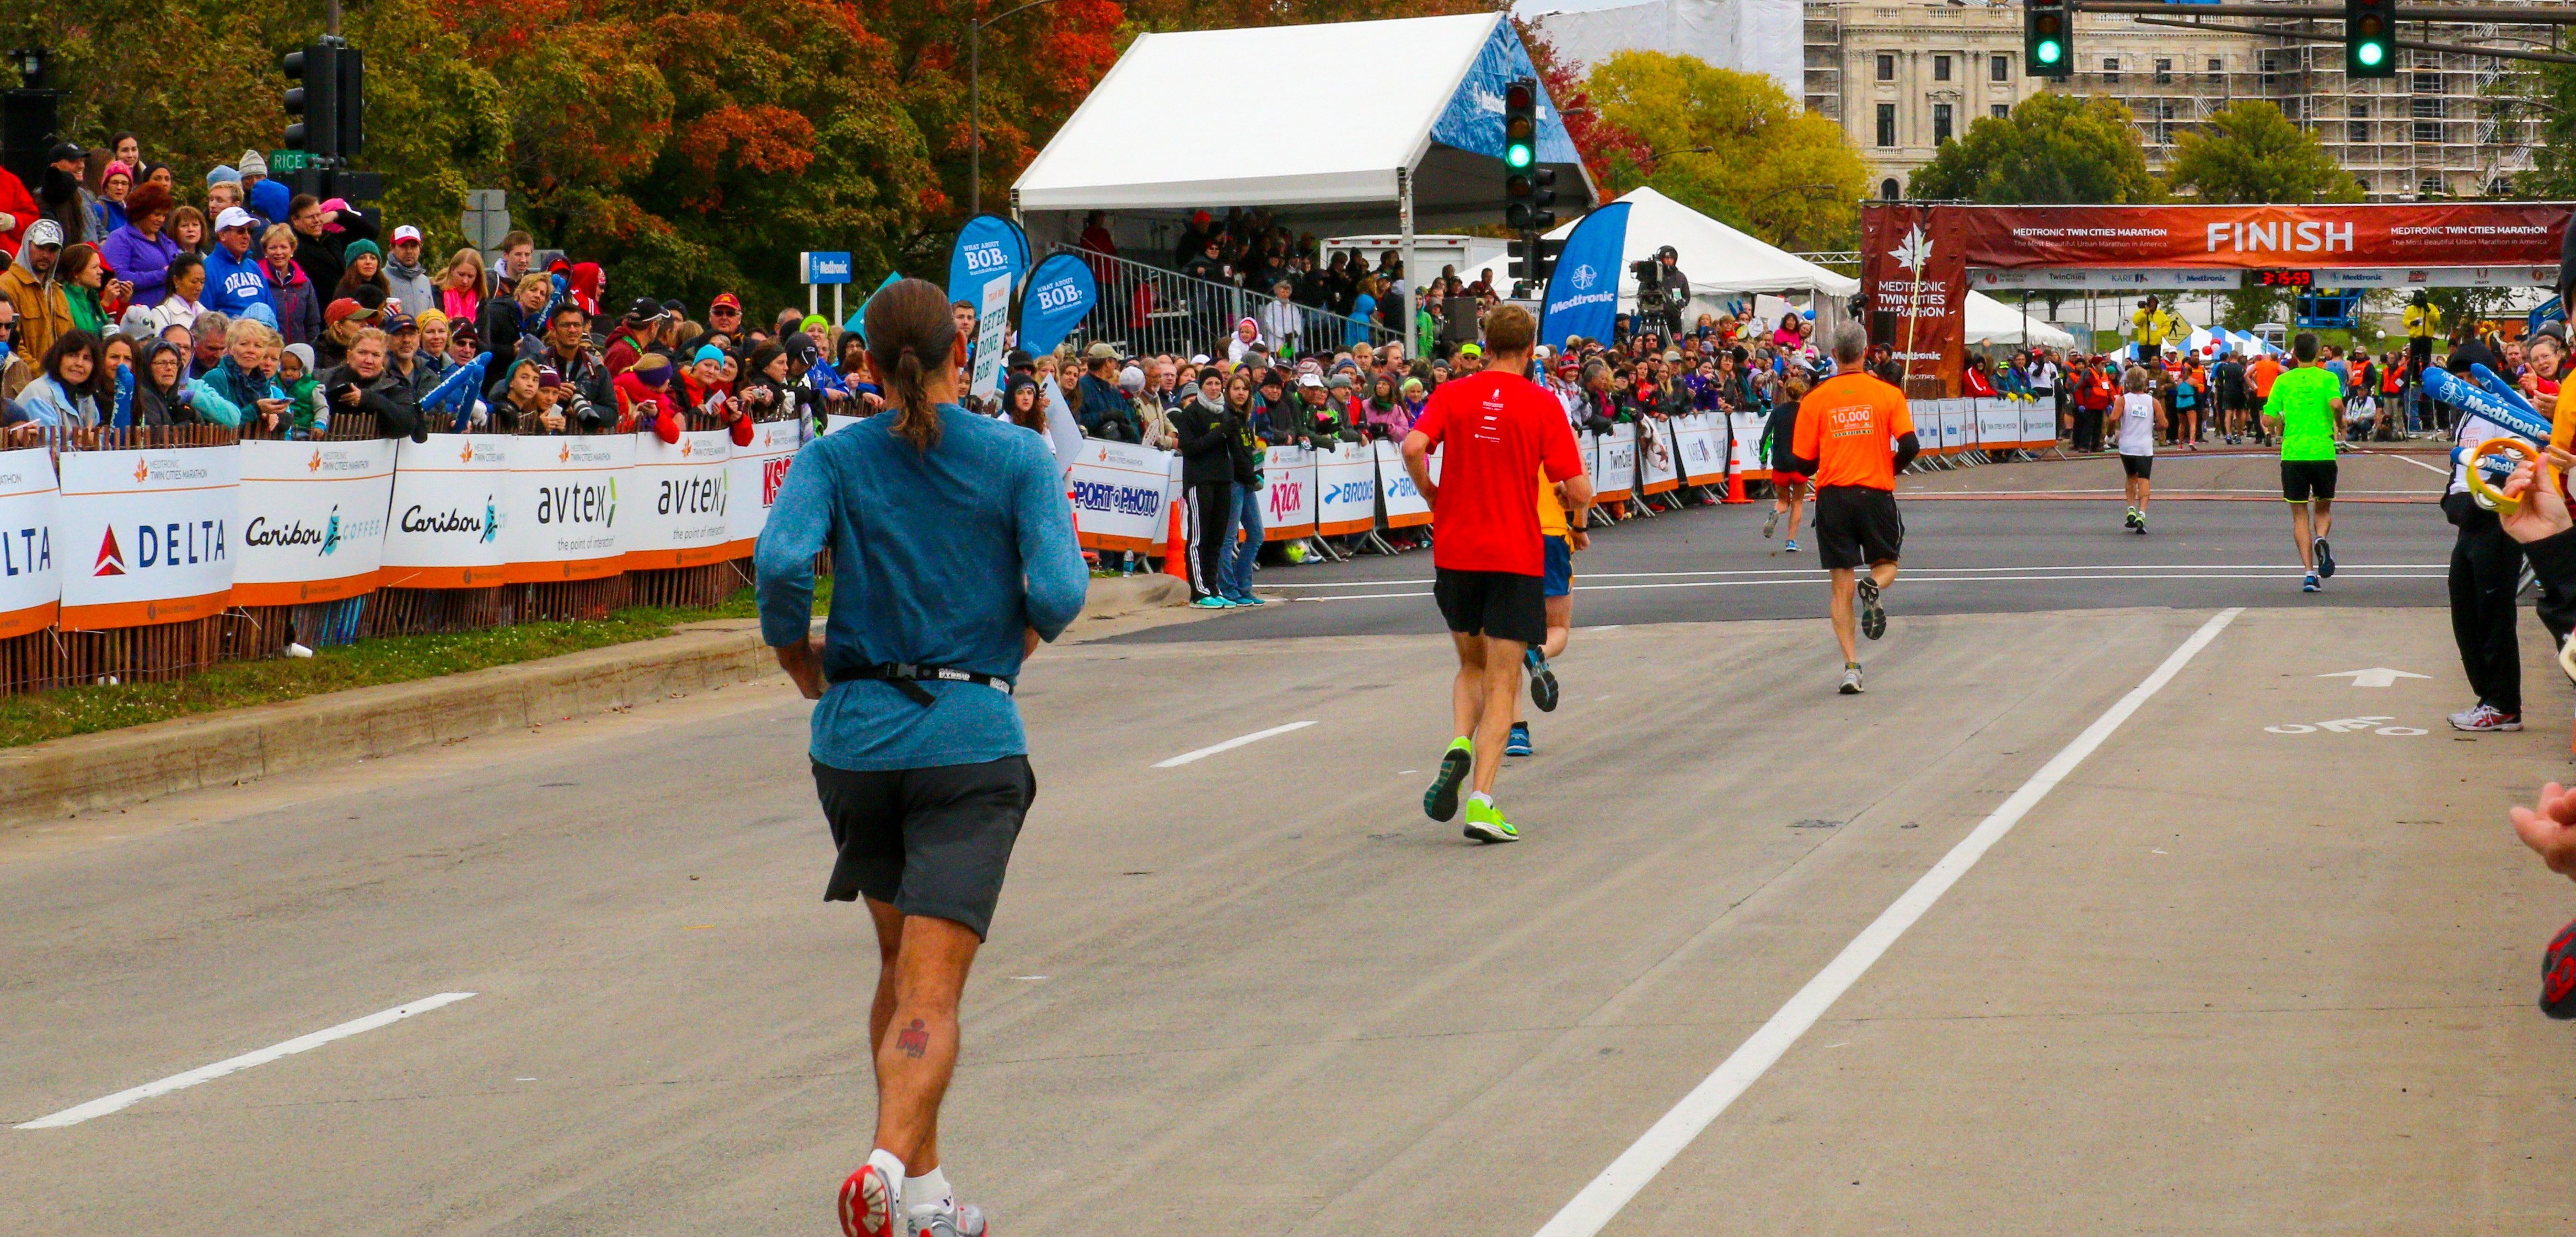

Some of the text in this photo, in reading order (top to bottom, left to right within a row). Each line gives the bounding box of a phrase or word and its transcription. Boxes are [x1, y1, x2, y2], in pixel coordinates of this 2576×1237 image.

[274, 154, 303, 169] RICE
[2013, 228, 2167, 236] MEDTRONIC TWIN CITIES MARATHON
[2207, 221, 2353, 252] FINISH
[2391, 227, 2443, 235] MEDTRONIC
[981, 240, 1000, 249] ABOUT
[964, 248, 1008, 270] BOB?
[1037, 277, 1074, 292] WHAT ABOUT
[1878, 281, 1946, 292] MEDTRONIC
[1037, 284, 1082, 310] BOB?
[1549, 291, 1614, 315] Medtronic
[1878, 294, 1945, 305] TWIN CITIES
[1832, 410, 1870, 424] 10,000
[151, 469, 207, 480] TWIN CITIES MARATHON
[658, 474, 721, 515] avtex
[1343, 480, 1373, 503] BROOKS
[538, 481, 605, 524] avtex
[401, 505, 481, 533] Caribou
[245, 517, 322, 546] Caribou
[343, 519, 380, 540] COFFEE
[673, 528, 684, 540] the
[684, 529, 700, 542] point
[139, 519, 225, 568] DELTA
[558, 537, 569, 551] the
[570, 539, 586, 552] point
[587, 536, 593, 549] of
